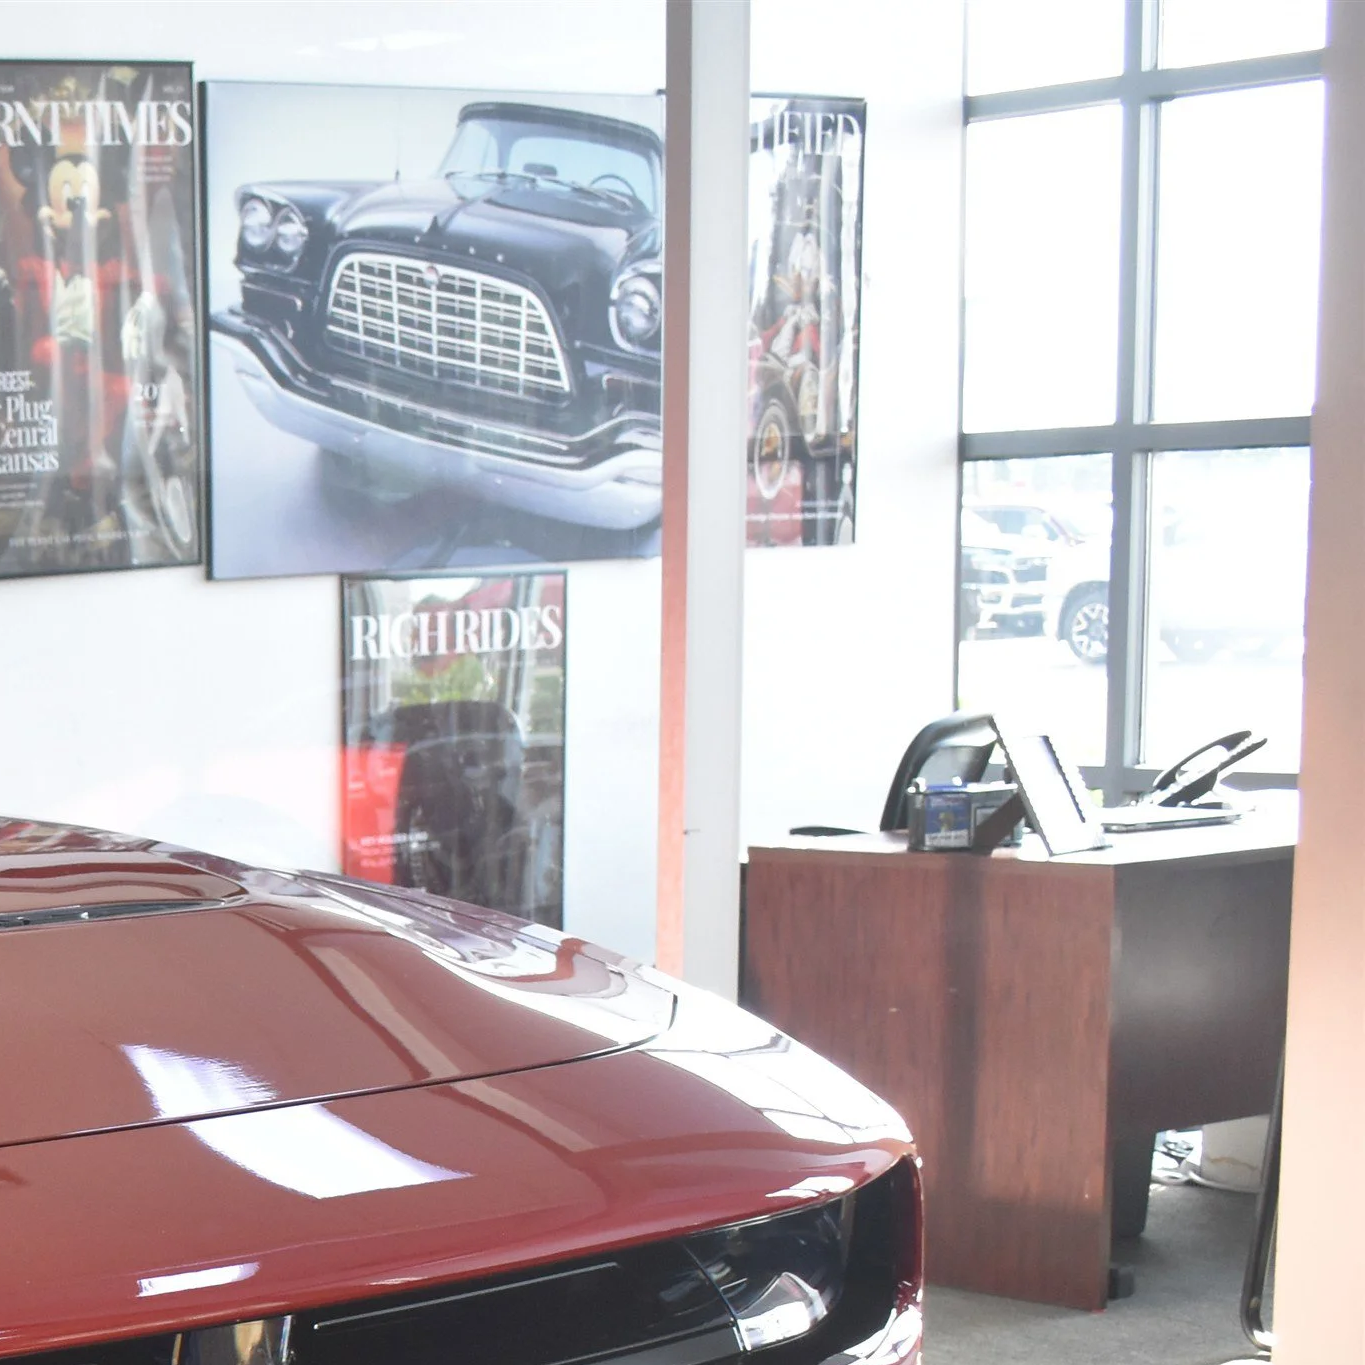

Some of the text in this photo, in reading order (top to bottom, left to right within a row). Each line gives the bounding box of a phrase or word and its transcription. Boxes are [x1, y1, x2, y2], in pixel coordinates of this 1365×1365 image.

[72, 101, 193, 147] TIMES
[6, 393, 54, 425] Plug
[352, 604, 563, 660] RICH RIDES
